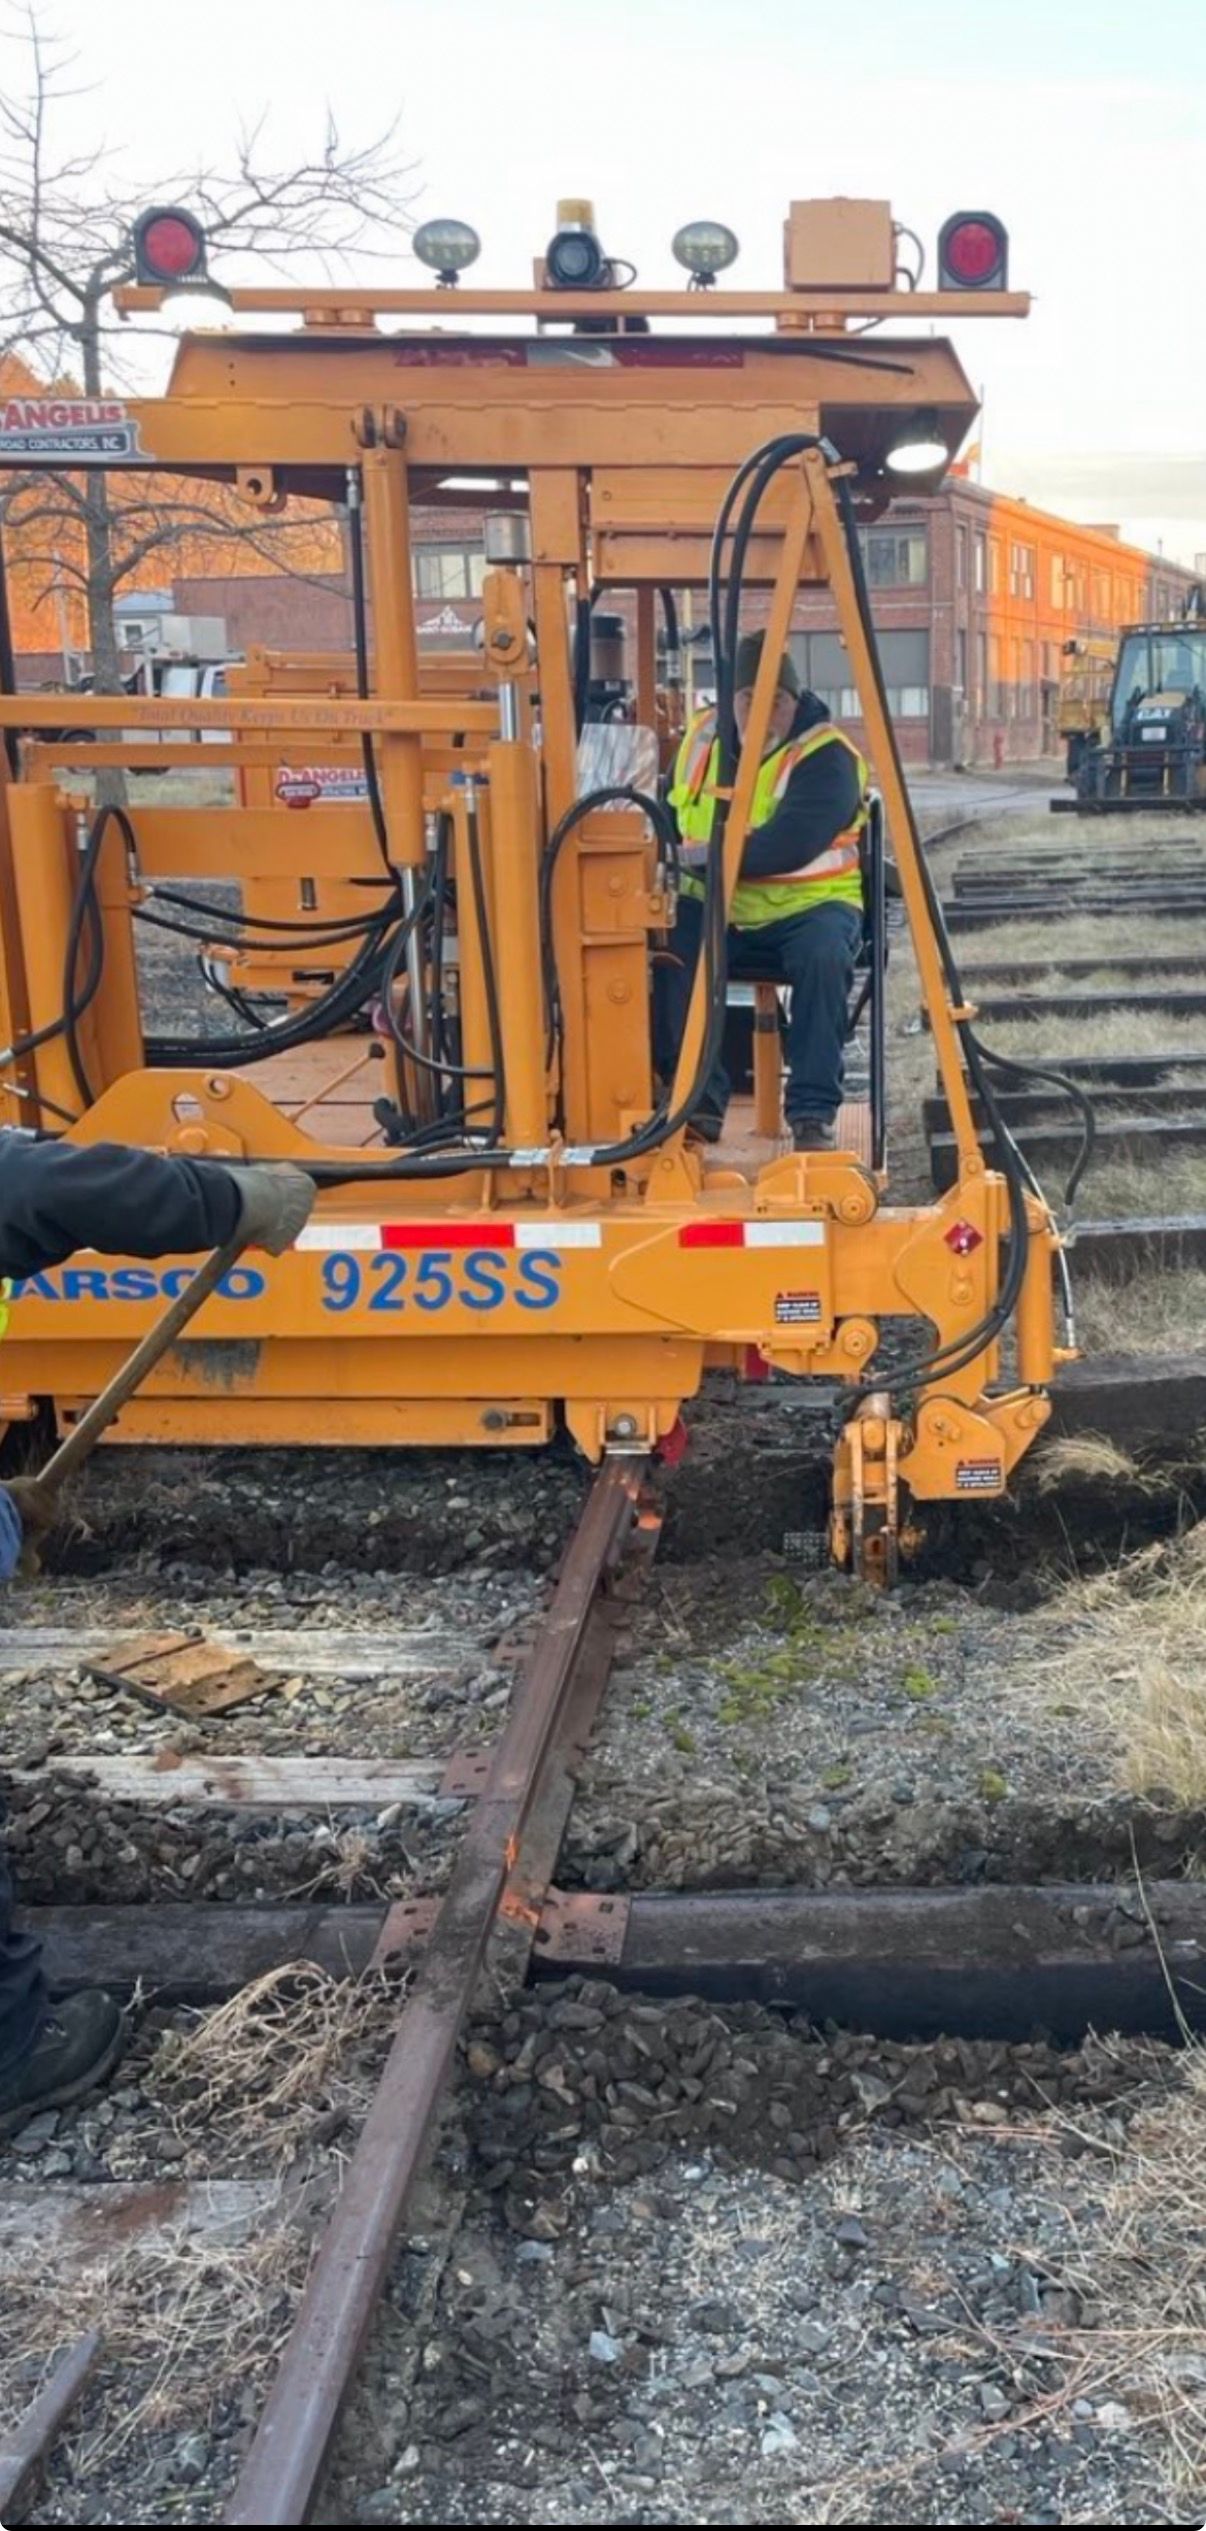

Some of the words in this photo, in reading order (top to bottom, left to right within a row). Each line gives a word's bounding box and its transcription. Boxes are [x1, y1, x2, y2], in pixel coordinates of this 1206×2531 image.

[0, 403, 123, 432] ANGELIS
[0, 437, 26, 450] ROAD
[9, 1268, 265, 1301] ARSCO
[321, 1250, 562, 1311] 925SS
